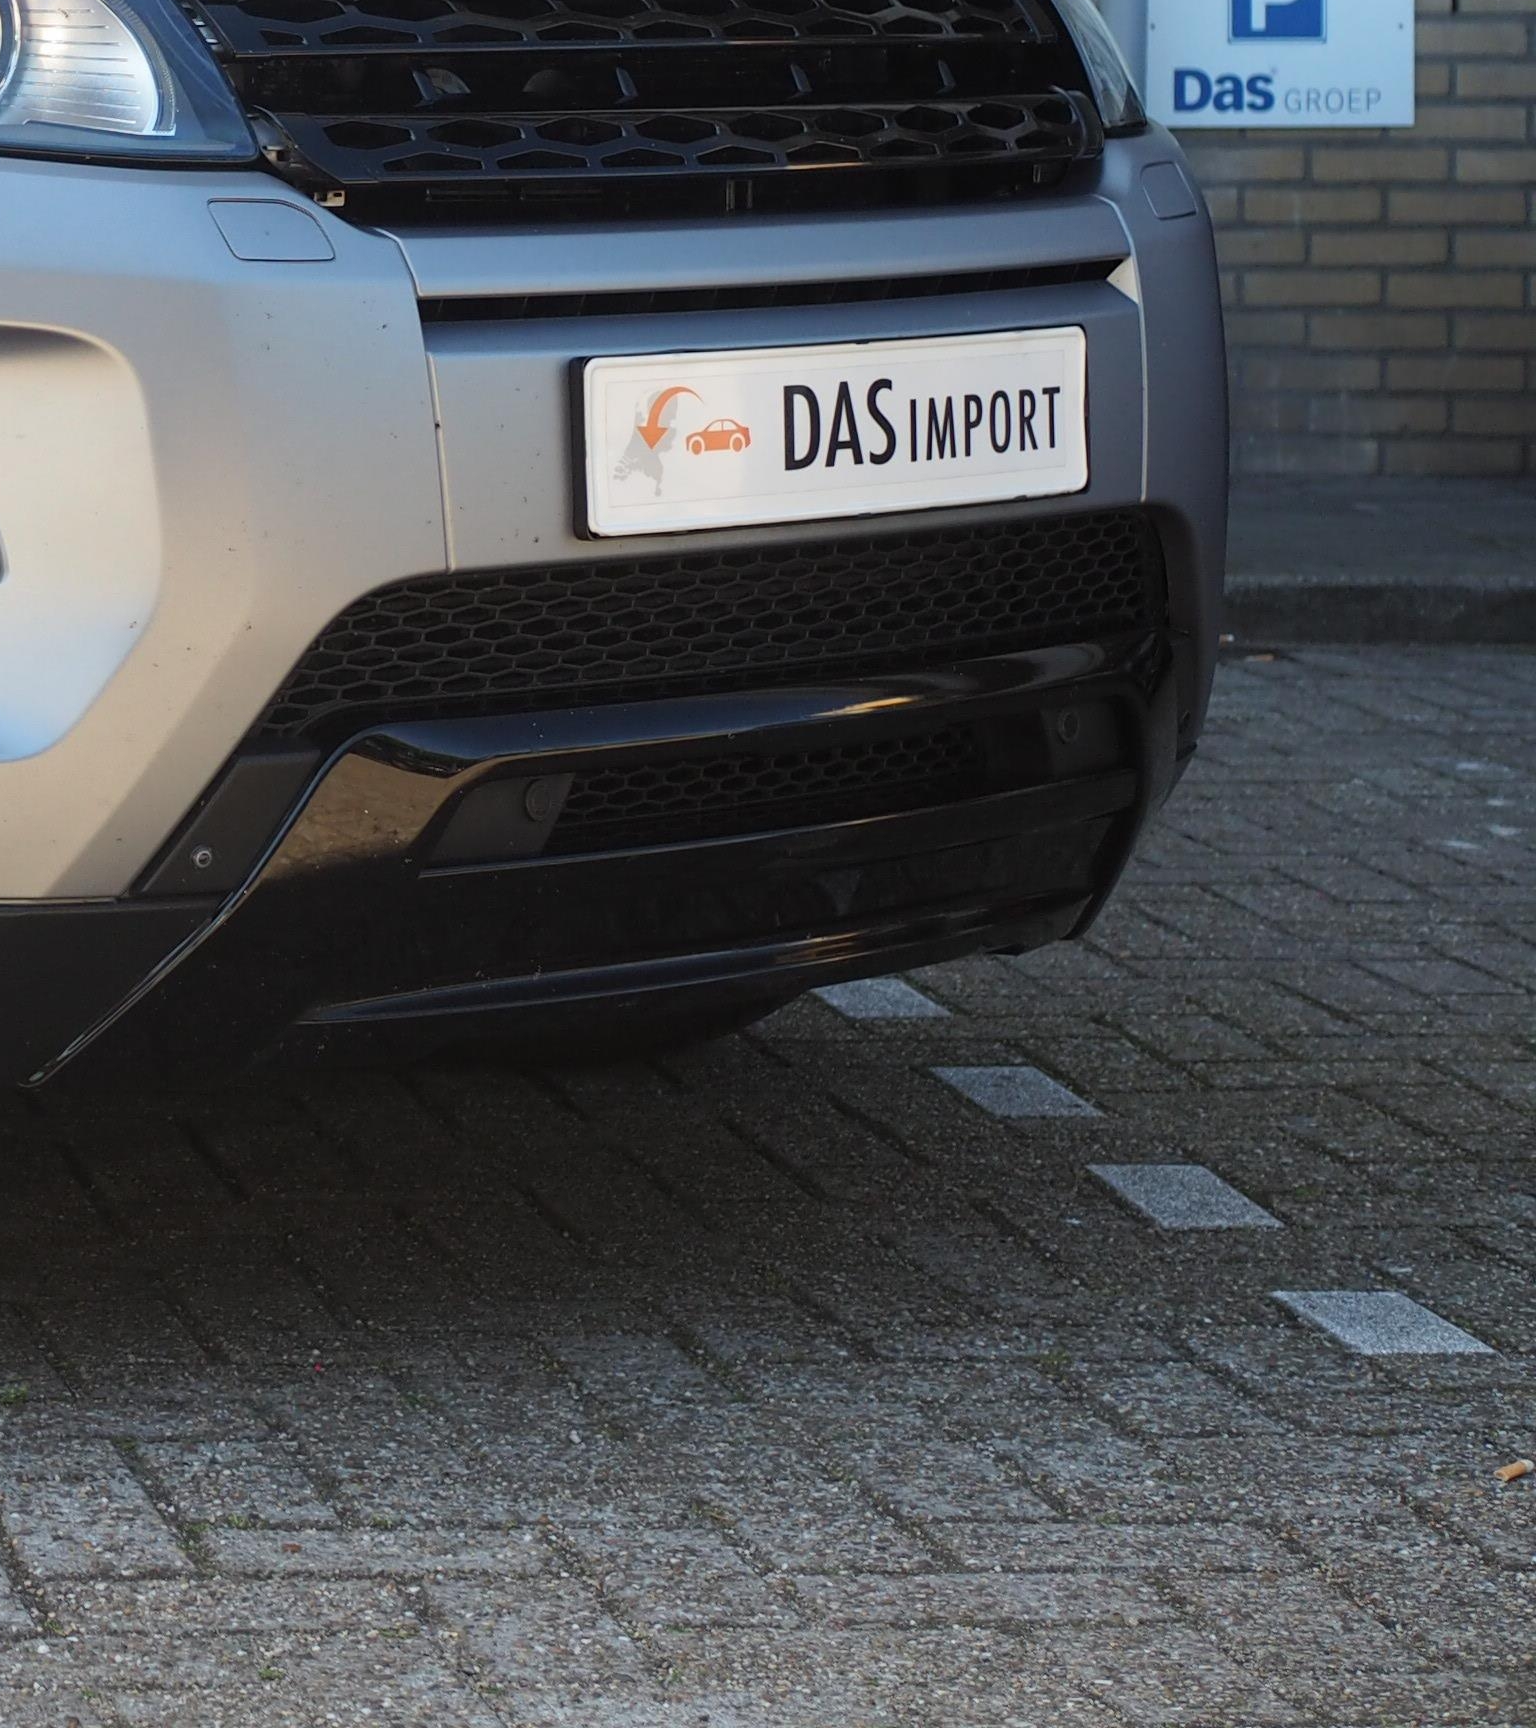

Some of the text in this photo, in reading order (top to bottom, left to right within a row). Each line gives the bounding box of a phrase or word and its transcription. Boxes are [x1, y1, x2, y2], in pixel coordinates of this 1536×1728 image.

[1283, 87, 1384, 115] GROEP
[783, 378, 1062, 472] DAS IMPORT
